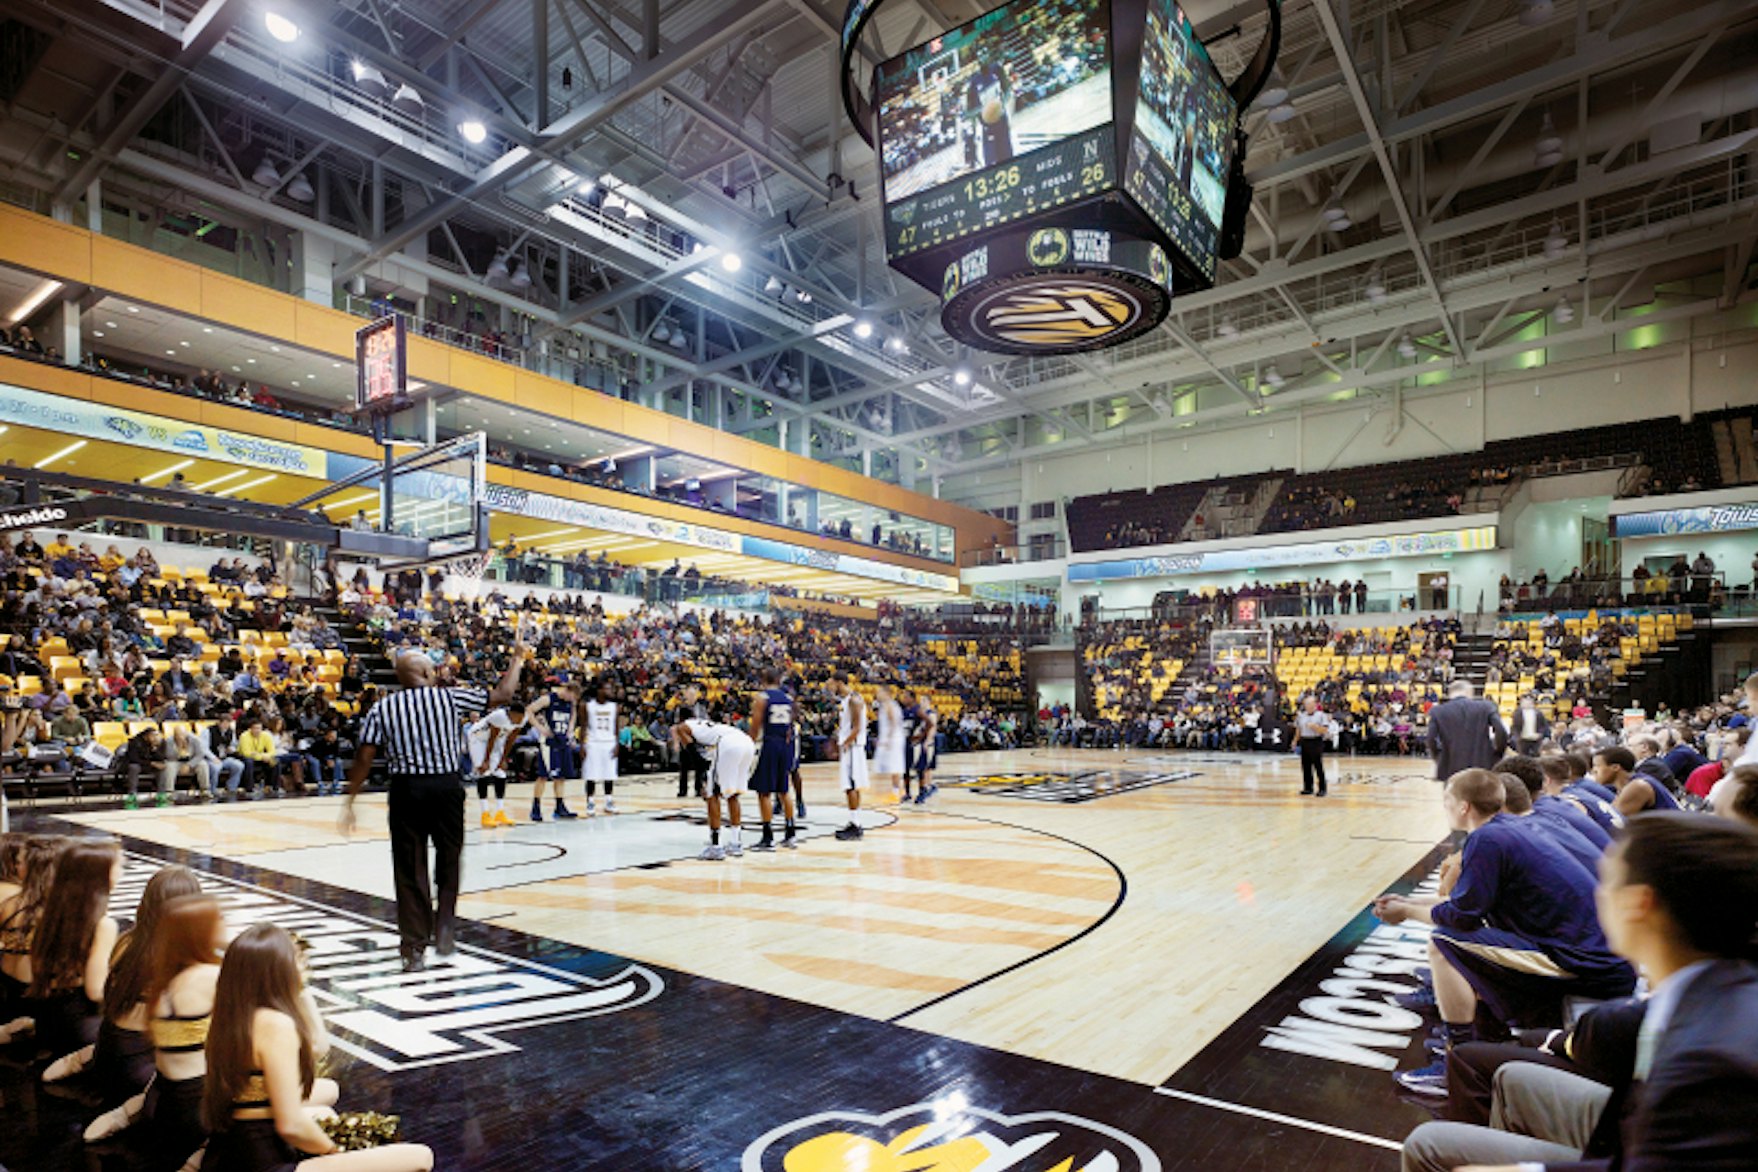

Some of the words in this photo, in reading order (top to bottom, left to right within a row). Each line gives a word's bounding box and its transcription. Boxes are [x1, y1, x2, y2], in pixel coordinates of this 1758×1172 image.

[964, 165, 1020, 202] 13:26
[1081, 163, 1104, 186] 26
[898, 226, 917, 244] 47
[1073, 238, 1110, 252] WILD
[769, 703, 792, 724] 25
